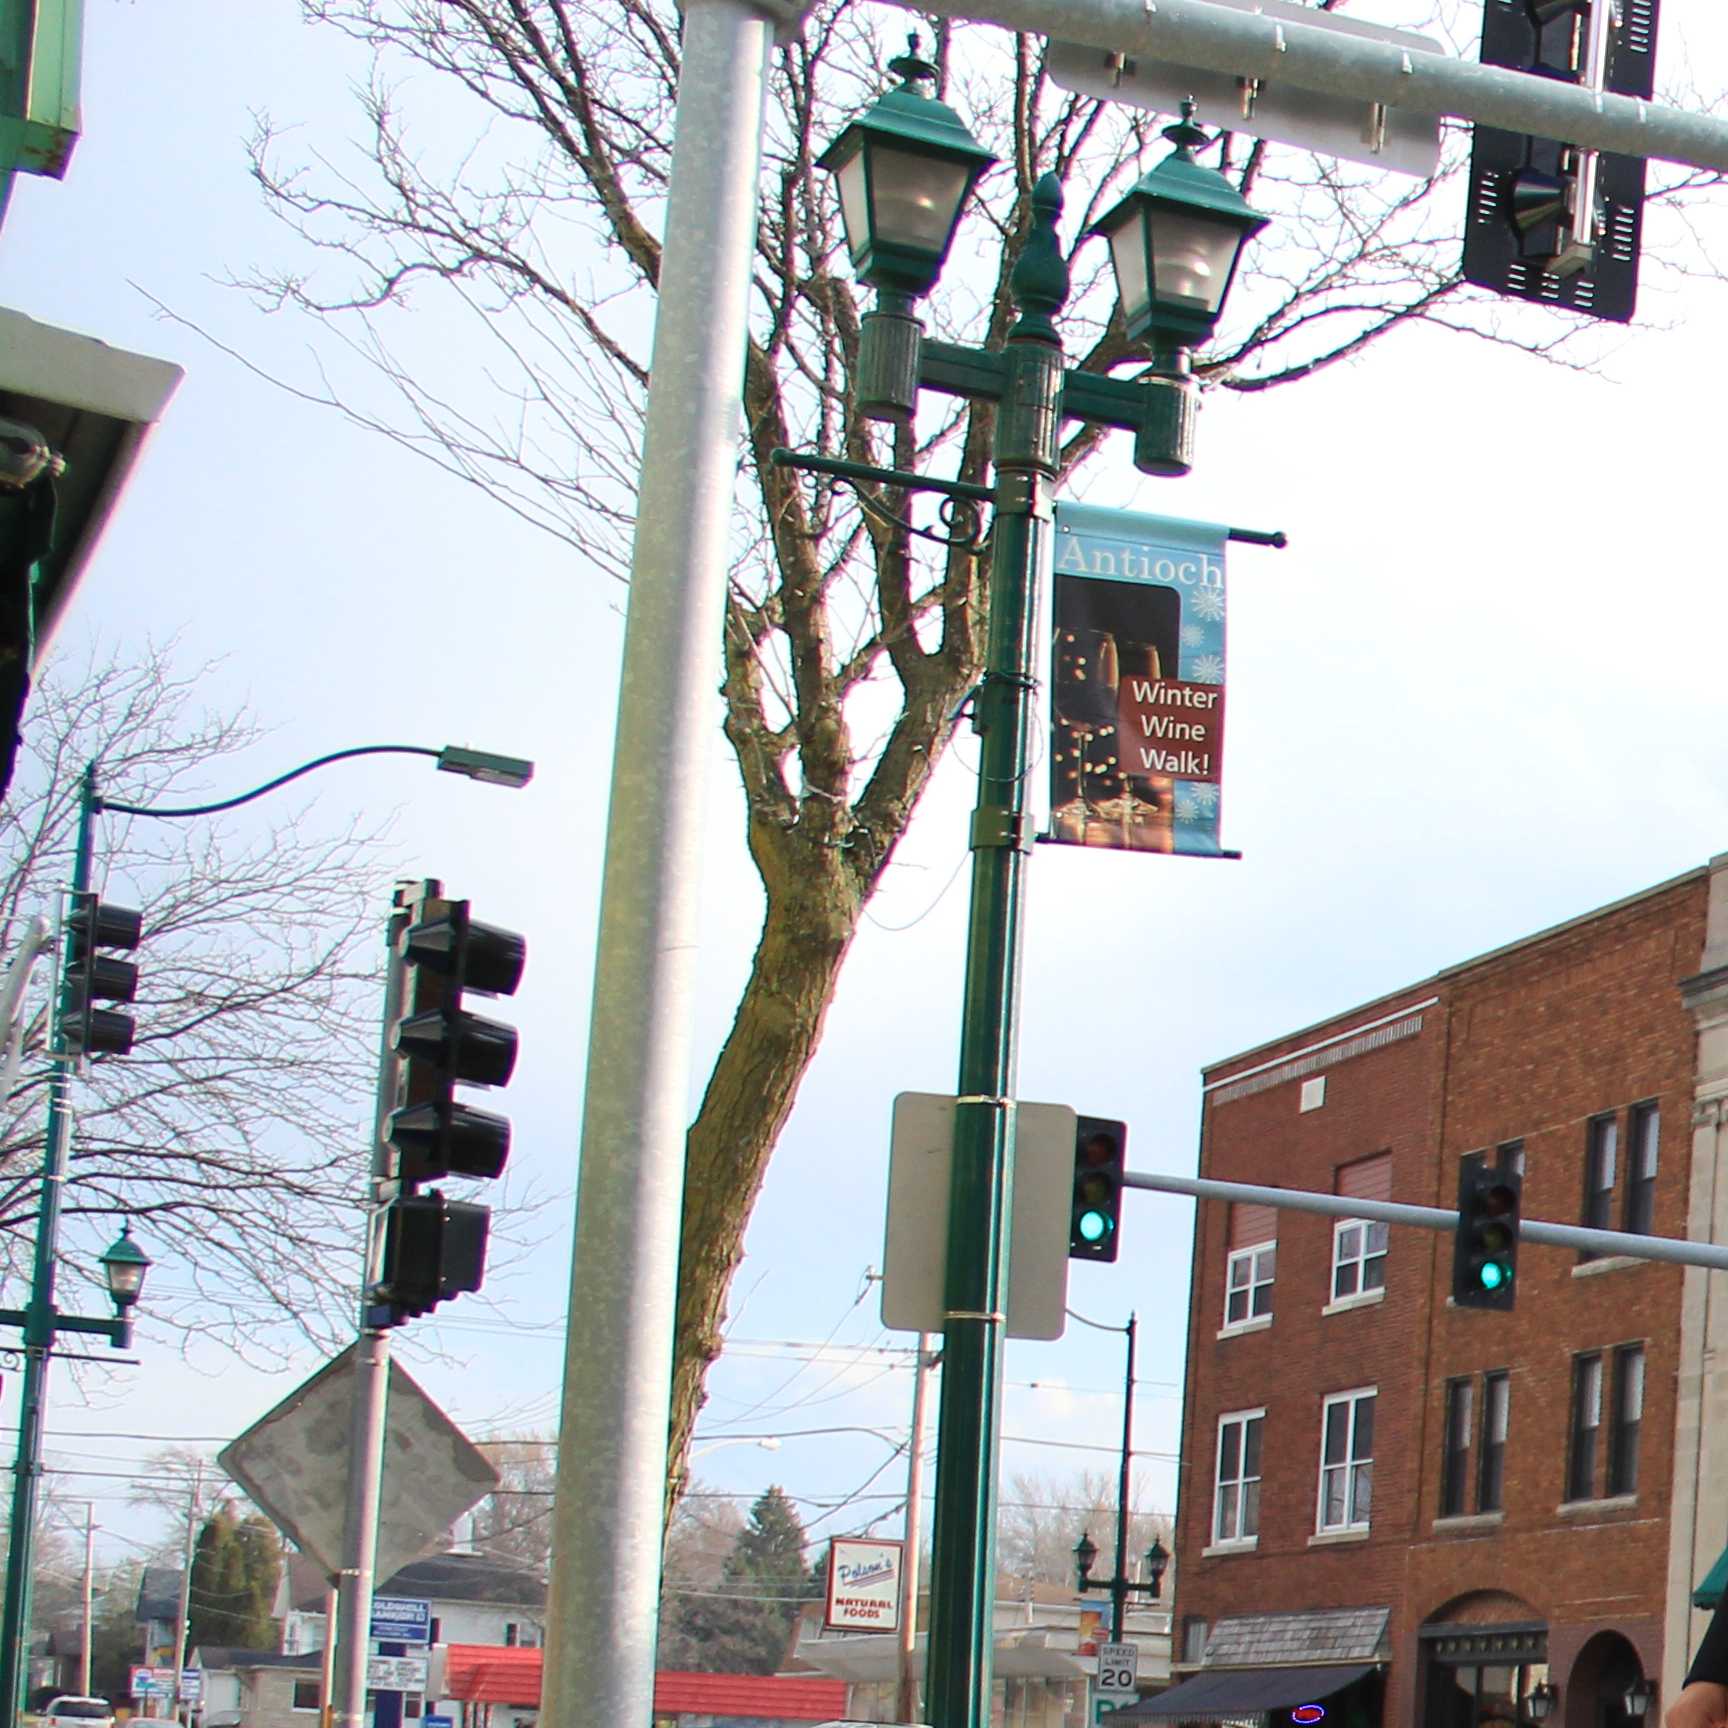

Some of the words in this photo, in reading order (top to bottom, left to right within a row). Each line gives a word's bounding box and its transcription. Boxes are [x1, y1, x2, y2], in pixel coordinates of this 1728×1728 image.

[1056, 535, 1225, 589] Antioch
[1132, 680, 1218, 709] Winter
[1140, 714, 1206, 742] Wine
[1139, 746, 1210, 776] Walk!
[836, 1597, 893, 1608] NATURAL
[843, 1607, 880, 1619] FOODS
[1103, 1647, 1135, 1658] SPEED
[1104, 1657, 1131, 1666] LIMIT
[1101, 1668, 1133, 1687] 20
